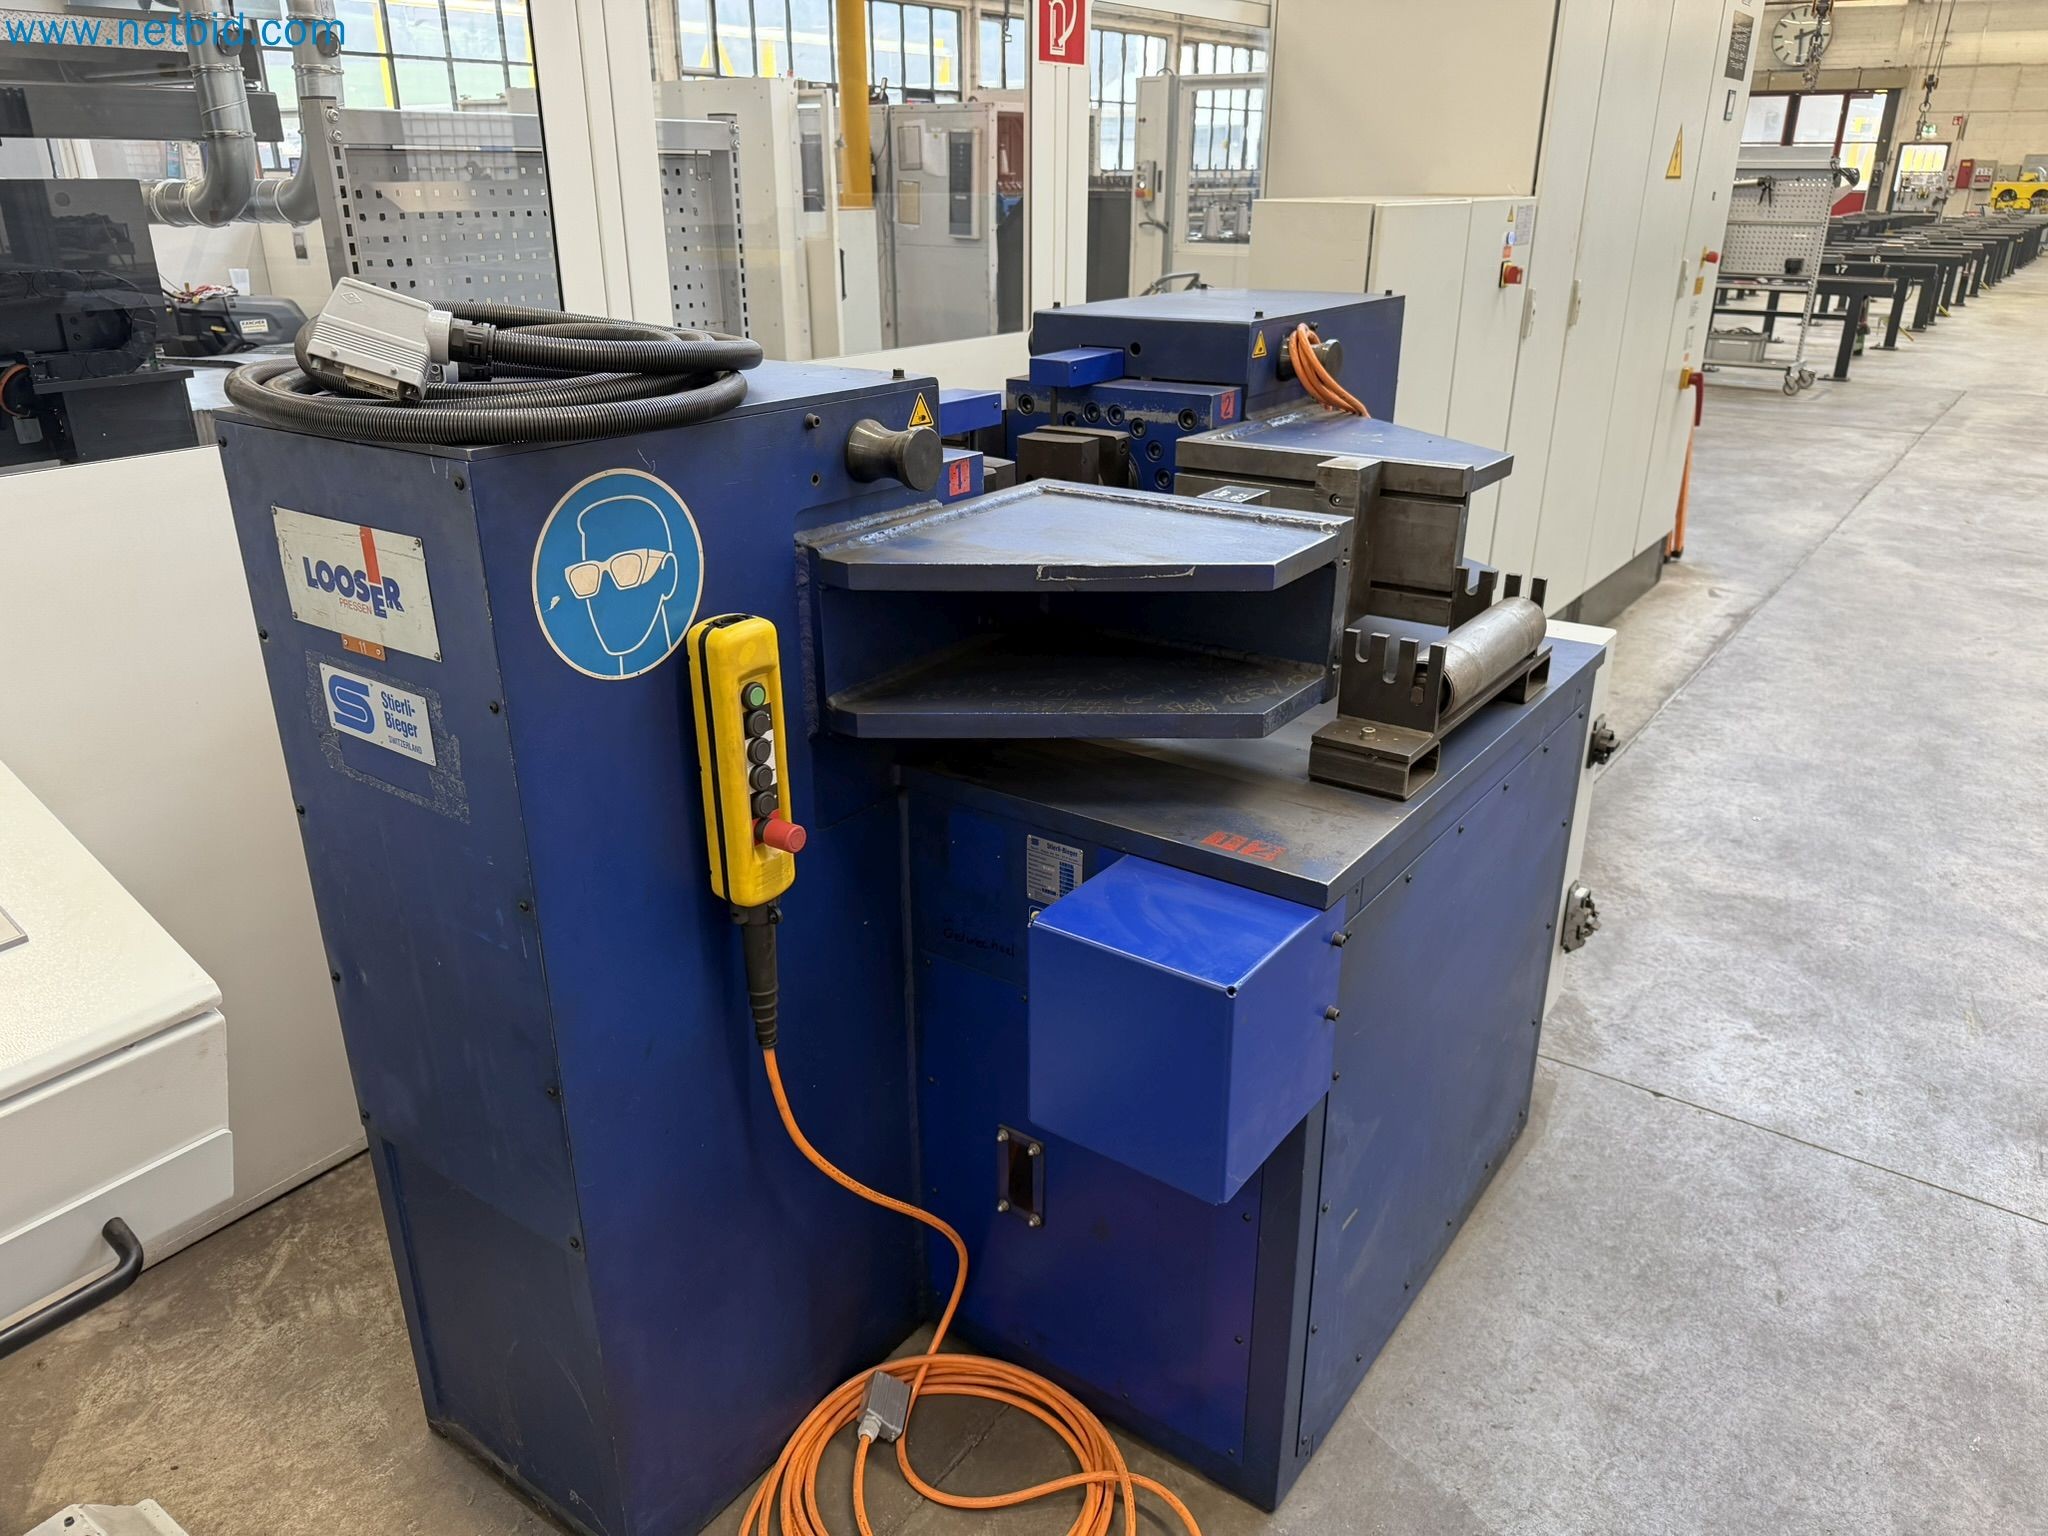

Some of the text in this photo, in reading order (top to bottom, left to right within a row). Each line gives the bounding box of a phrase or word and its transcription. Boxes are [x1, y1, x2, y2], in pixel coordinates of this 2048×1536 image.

[1834, 263, 1849, 274] 17
[1869, 255, 1882, 264] 16
[302, 556, 405, 619] LOOSER
[339, 598, 373, 615] PRESSEN
[381, 690, 416, 718] Stierli-
[384, 710, 418, 738] Bieger
[388, 735, 423, 755] SWITZERLAND
